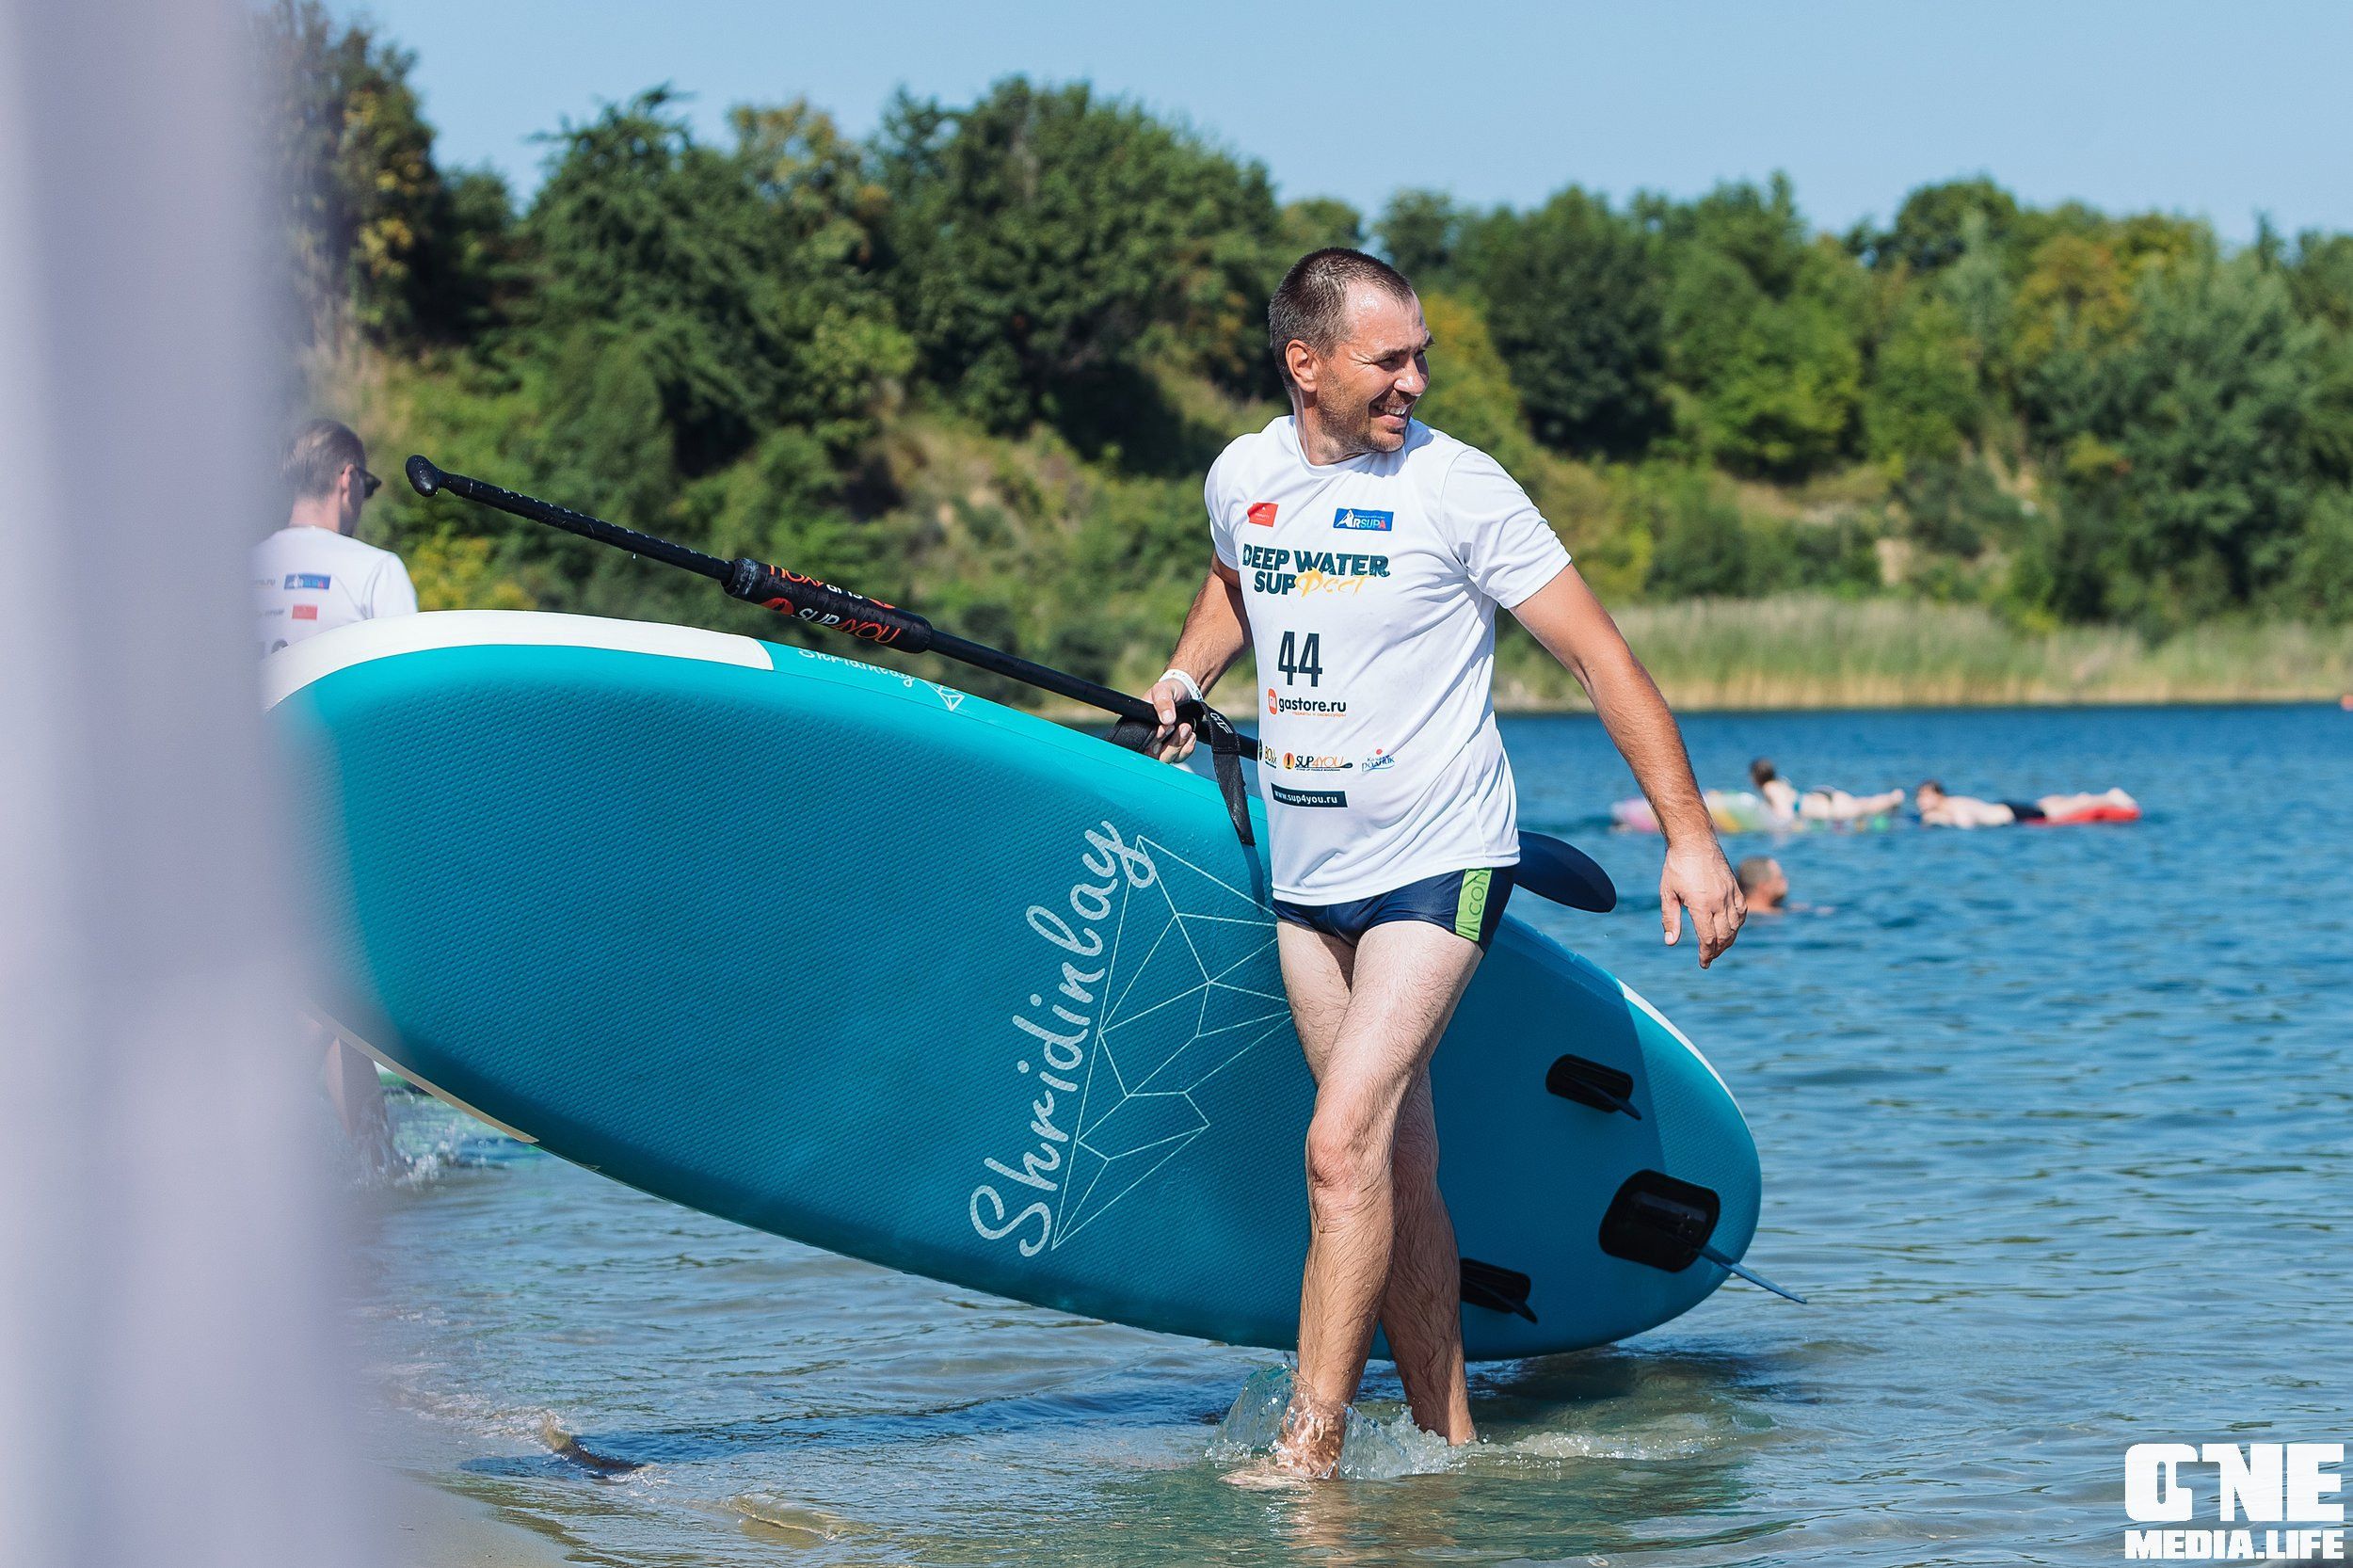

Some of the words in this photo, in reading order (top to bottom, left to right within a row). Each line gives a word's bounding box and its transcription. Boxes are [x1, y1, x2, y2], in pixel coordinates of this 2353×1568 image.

[1242, 543, 1290, 570] DEEP
[1293, 550, 1391, 577] WATER
[1254, 570, 1297, 595] SUP
[1278, 631, 1322, 687] 44
[1278, 697, 1347, 712] gastore.ru
[1295, 755, 1344, 768] SUP4YOU
[1273, 790, 1338, 805] www.sup4you.ru
[969, 820, 1157, 1257] Shridinlay
